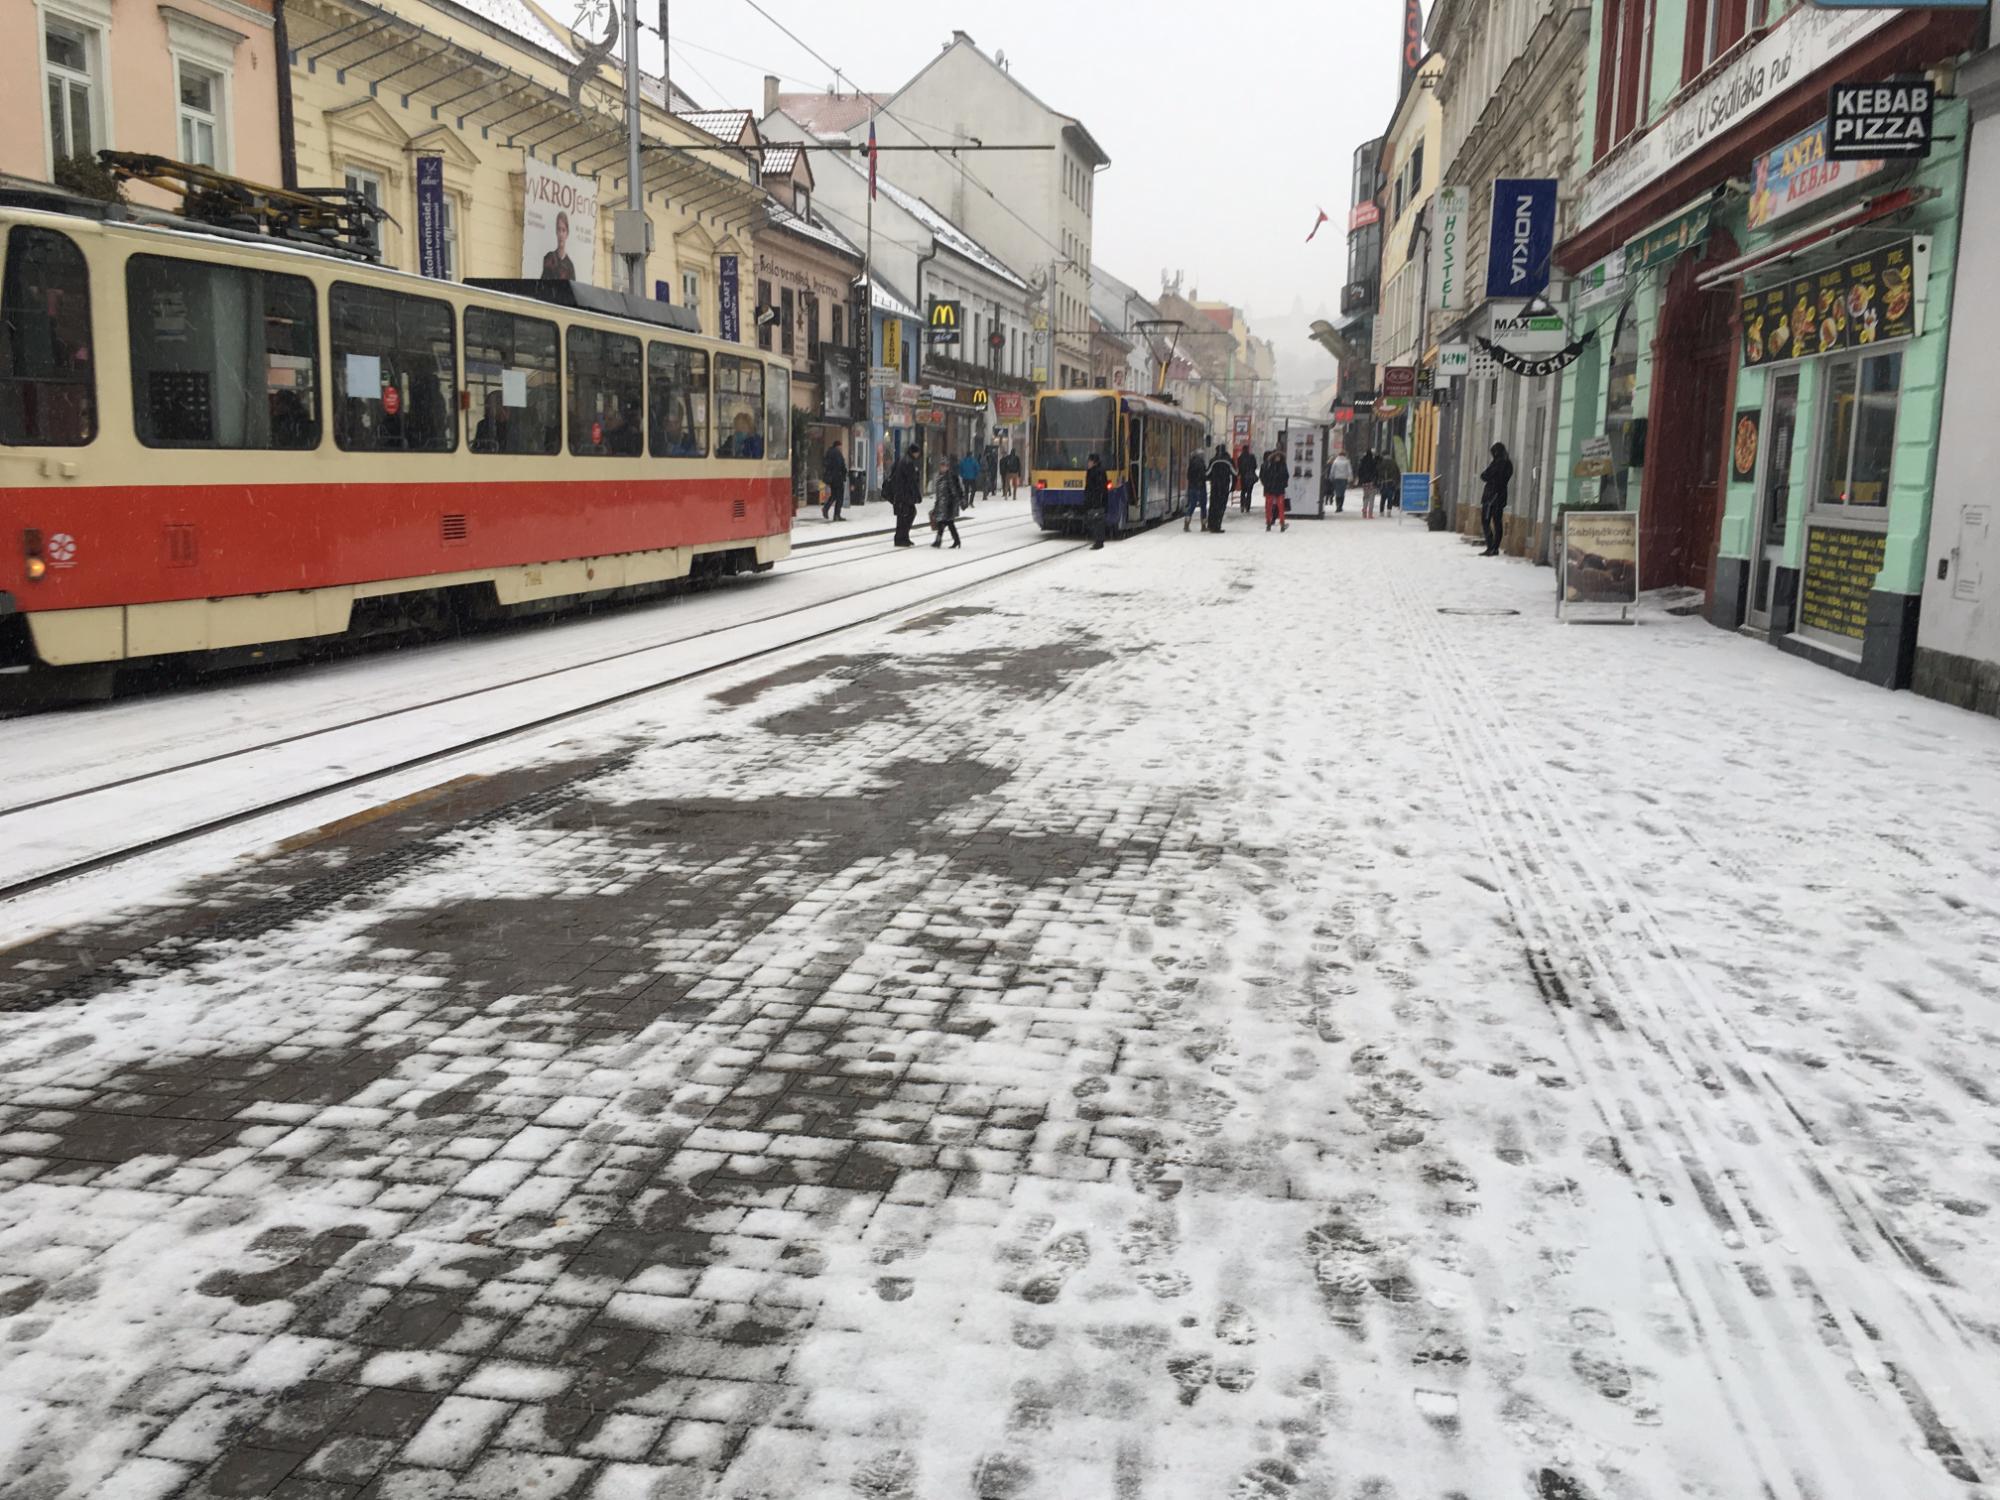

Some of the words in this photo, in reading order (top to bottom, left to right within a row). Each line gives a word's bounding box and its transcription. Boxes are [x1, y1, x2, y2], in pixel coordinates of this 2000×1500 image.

[1768, 53, 1792, 90] Pub
[1836, 88, 1928, 115] KEBAB
[1834, 117, 1926, 141] PIZZA
[1780, 130, 1824, 178] ANTA
[1787, 161, 1841, 202] KEBAB
[1510, 195, 1533, 285] NOKIA
[1441, 215, 1457, 309] HOSTEL
[1494, 318, 1530, 331] MAX
[1502, 353, 1576, 376] VIECHA
